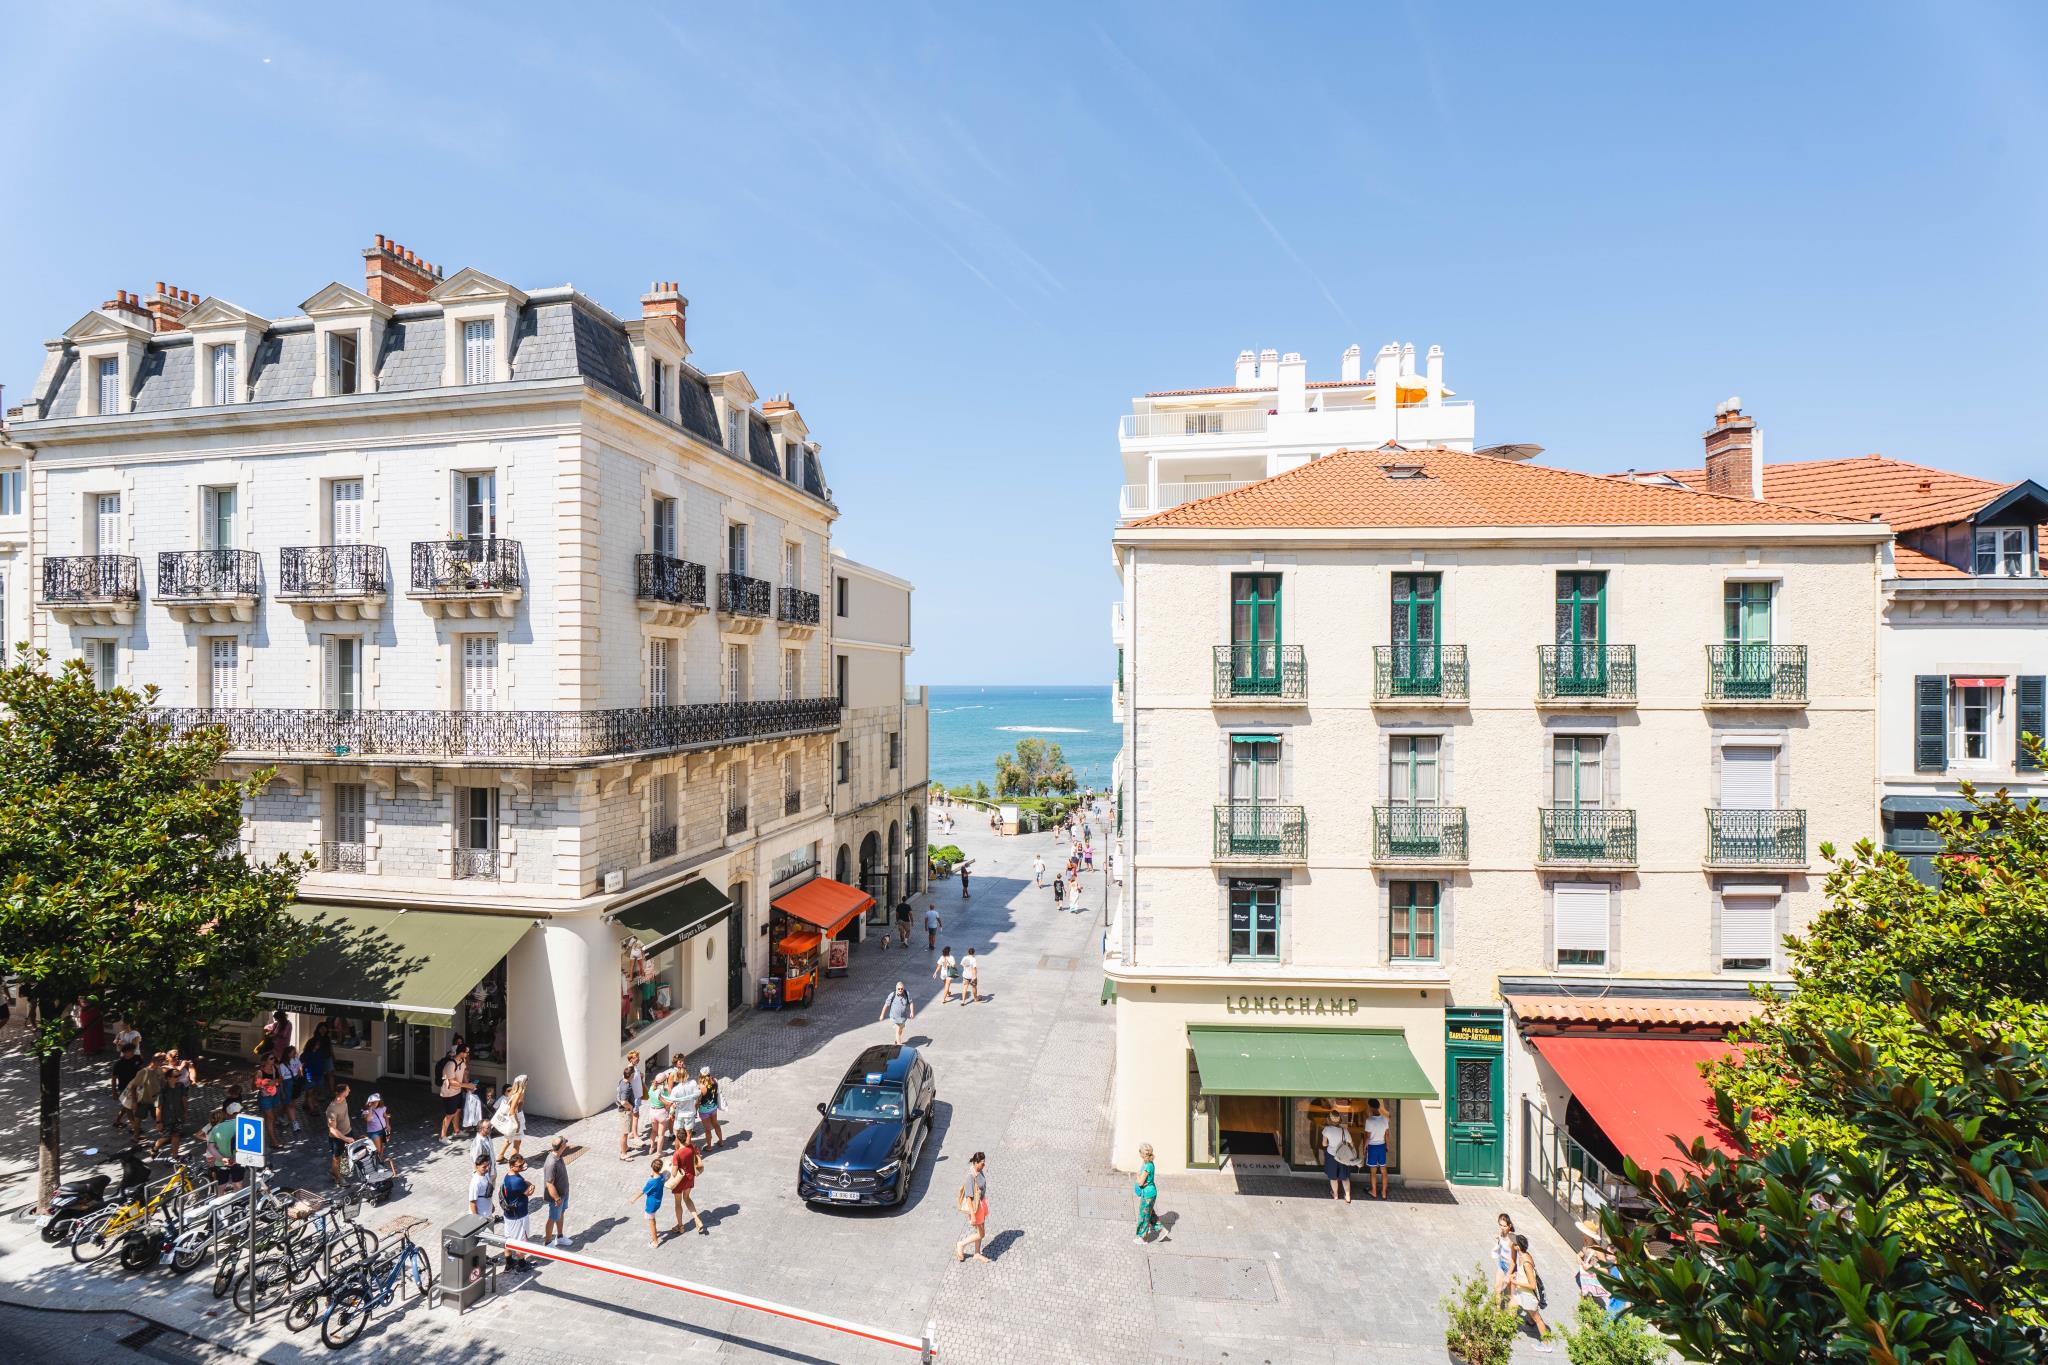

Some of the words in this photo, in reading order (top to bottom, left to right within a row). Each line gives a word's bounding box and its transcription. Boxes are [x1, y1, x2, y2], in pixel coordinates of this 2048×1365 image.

[277, 1000, 302, 1012] Harper
[309, 1003, 326, 1014] Flint
[1226, 996, 1359, 1016] LONGCHAMP
[243, 1123, 256, 1146] P
